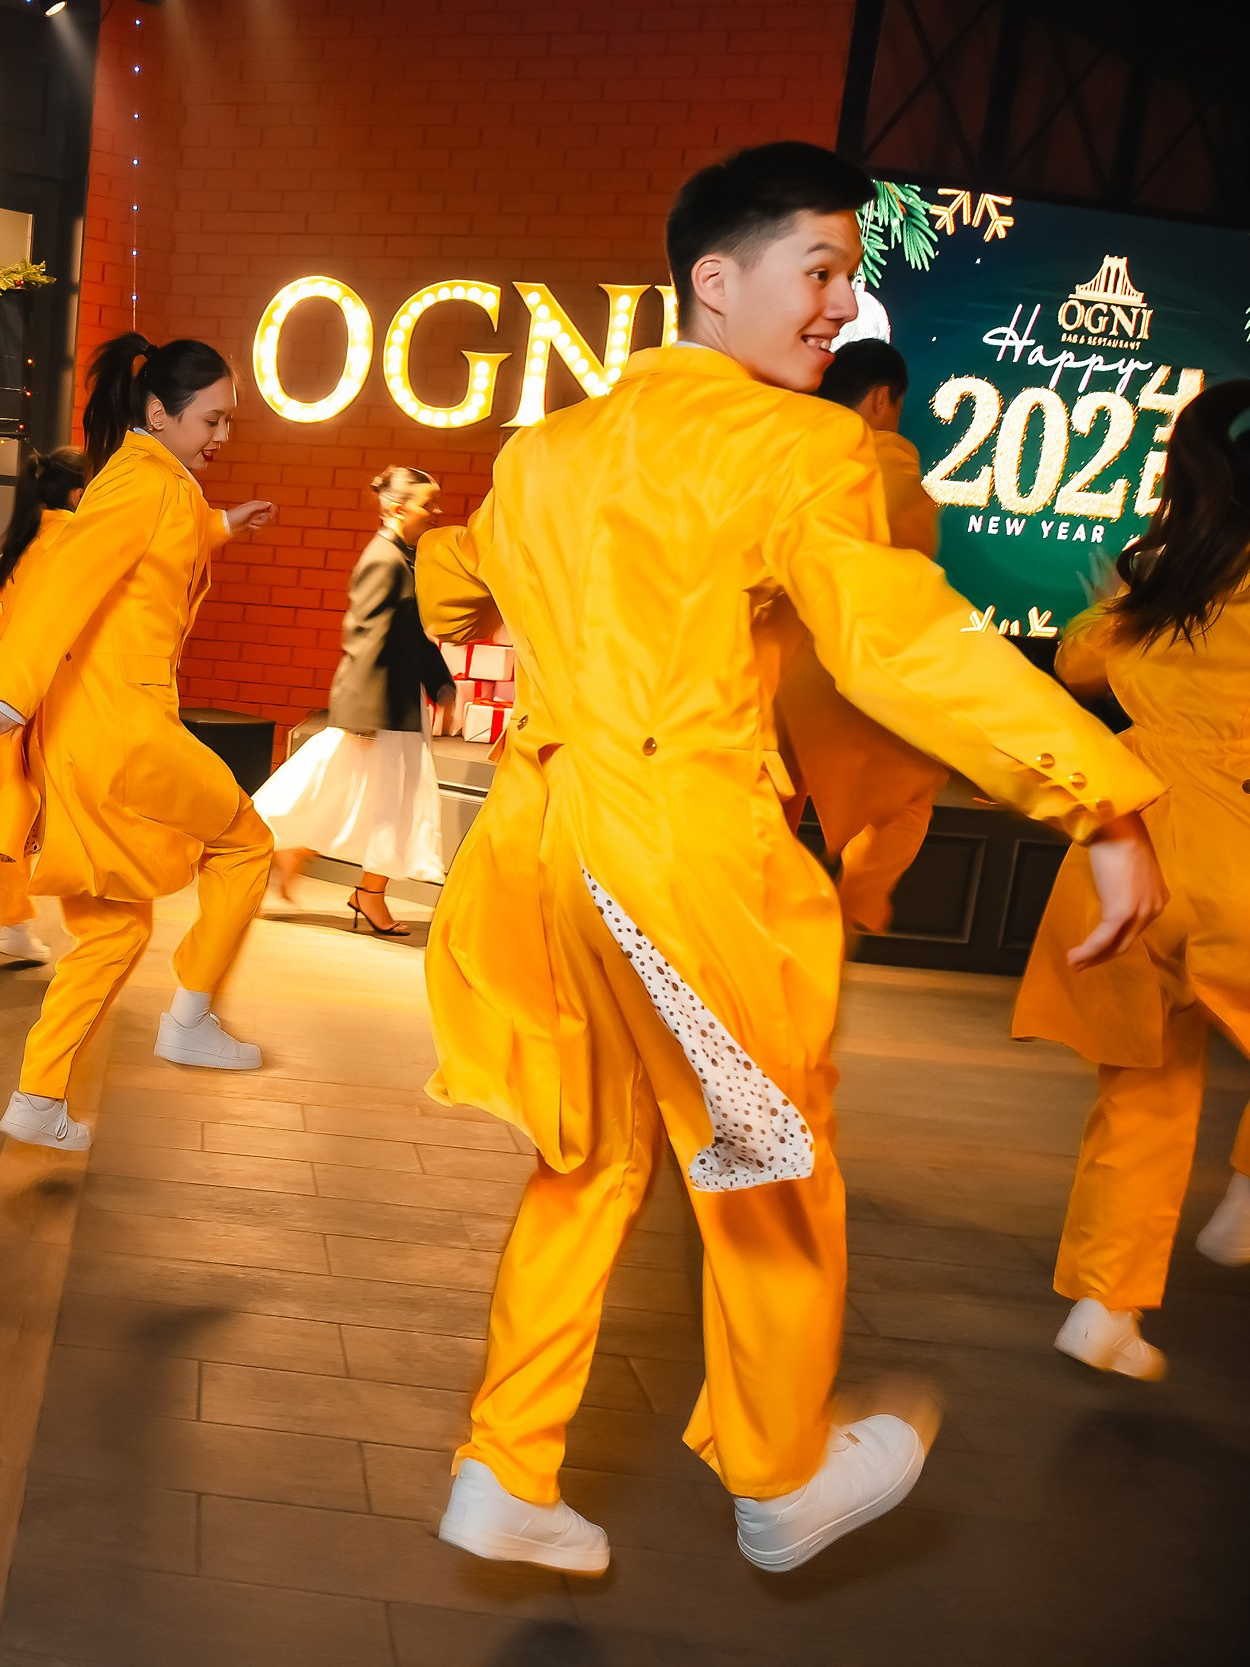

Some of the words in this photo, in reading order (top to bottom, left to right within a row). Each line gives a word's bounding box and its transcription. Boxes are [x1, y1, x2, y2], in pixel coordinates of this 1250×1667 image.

[1058, 300, 1153, 340] OGNI
[981, 303, 1153, 394] Happy
[967, 514, 1027, 537] NEW
[1040, 519, 1106, 544] YEAR
